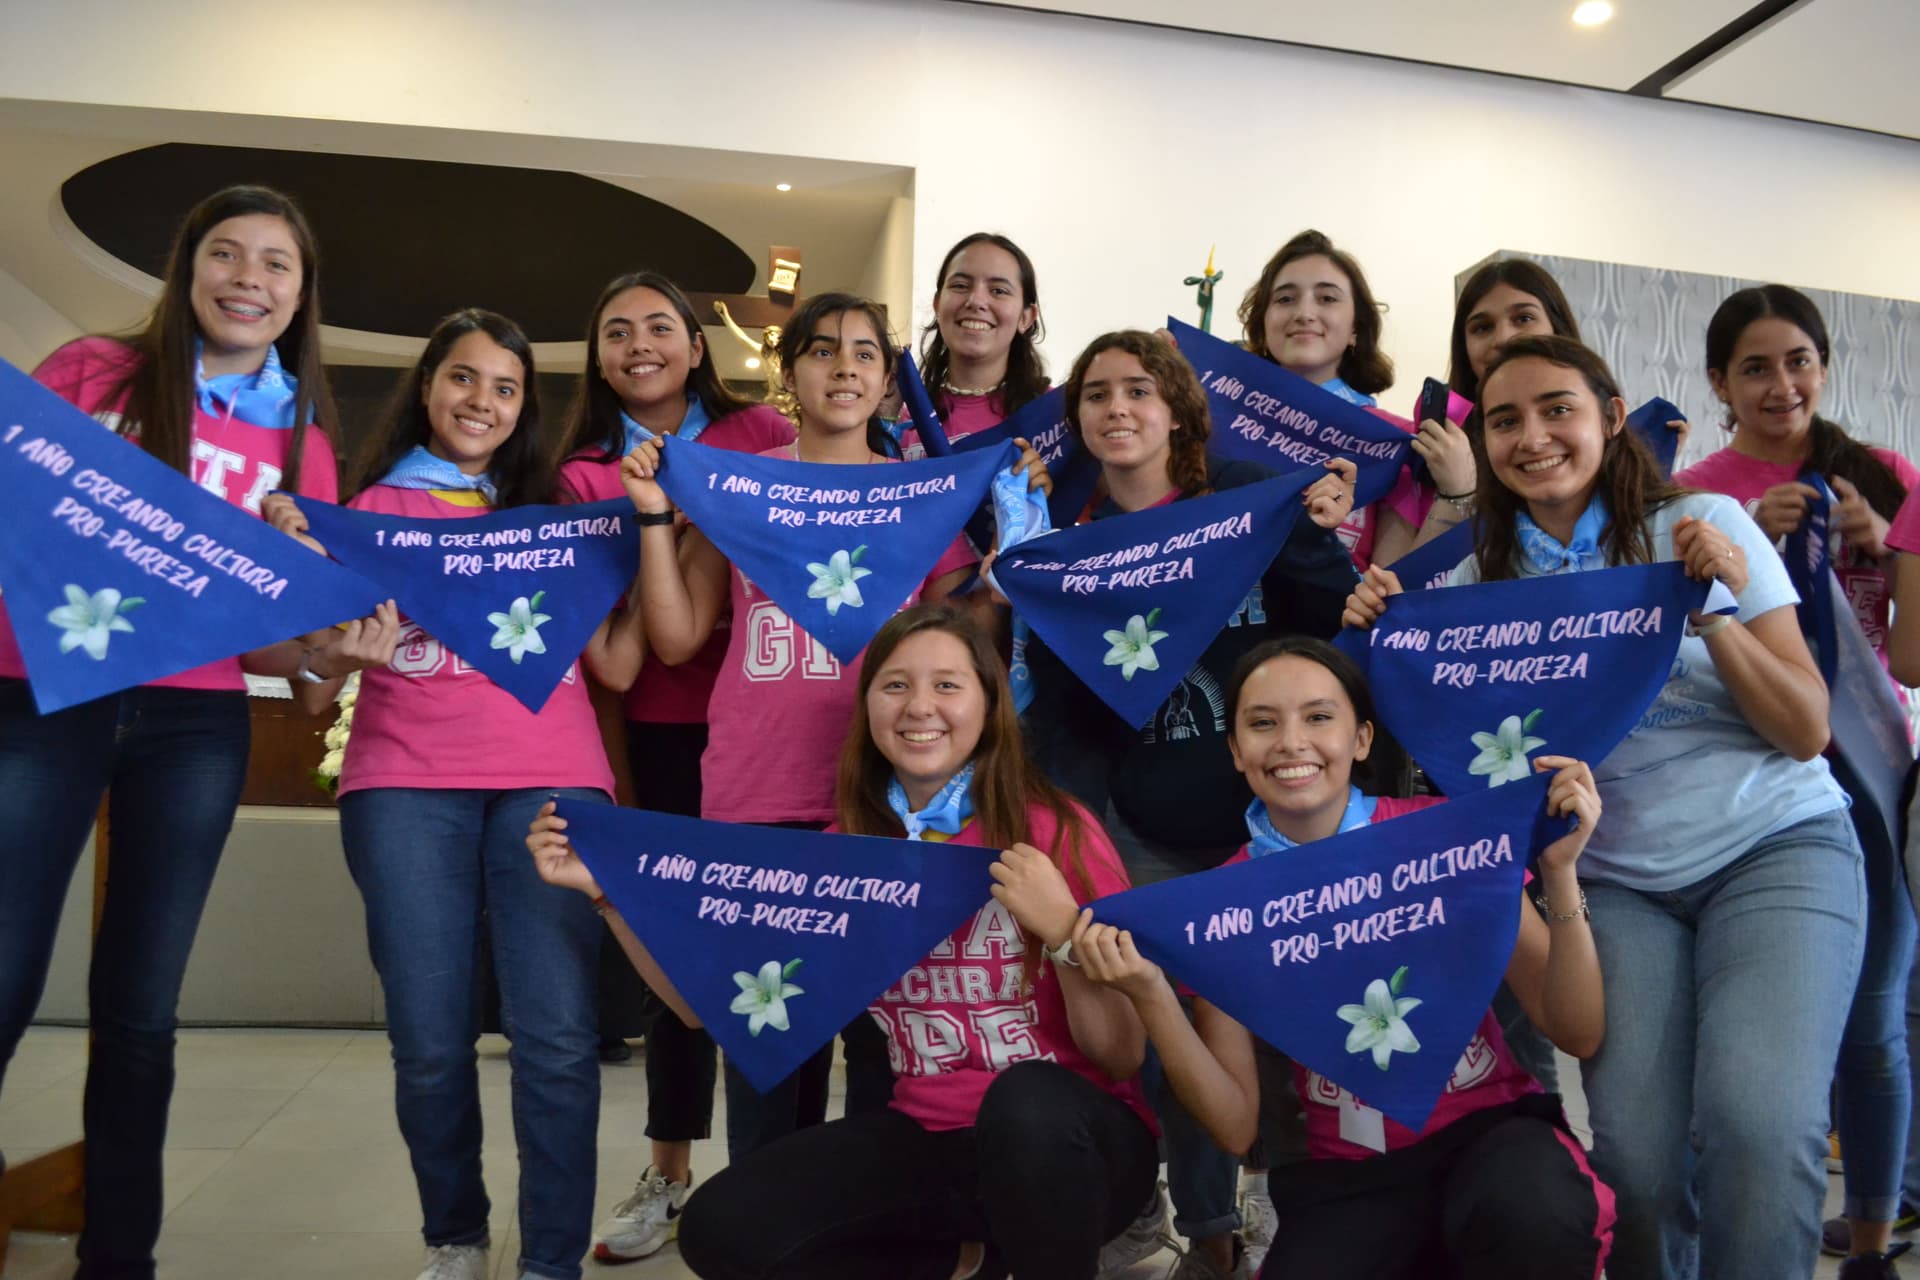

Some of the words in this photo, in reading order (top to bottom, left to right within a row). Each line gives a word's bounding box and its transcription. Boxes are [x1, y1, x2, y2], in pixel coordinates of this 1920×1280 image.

[1200, 370, 1213, 384] 1
[1210, 375, 1245, 400] AÑO
[1243, 390, 1318, 436] CREANDO
[1319, 426, 1401, 460] CULTURA
[1230, 413, 1333, 467] PRO-PUREZ
[2, 425, 24, 444] 1
[19, 437, 75, 477] AÑO
[72, 468, 186, 542] CREANDO
[181, 533, 289, 601] CULTURA
[708, 472, 716, 489] 1
[721, 474, 761, 496] AÑO
[767, 484, 860, 505] CREANDO
[867, 474, 956, 503] CULTURA
[375, 529, 385, 547] 1
[391, 529, 432, 548] AÑO
[439, 528, 532, 548] CREANDO
[538, 515, 622, 541] CULTURA
[768, 506, 902, 528] PRO-PUREZA
[1067, 542, 1159, 572] CREANDO
[1162, 511, 1252, 553] CULTURA
[52, 496, 210, 598] PRO-PUREZA
[443, 547, 575, 576] PRO-PUREZA
[1061, 556, 1194, 595] PRO-PUREZA
[1382, 627, 1430, 652] AÑO
[1436, 620, 1542, 653] CREANDO
[1548, 606, 1662, 643] CULTURA
[1432, 652, 1589, 689] PRO-PUREZA
[637, 853, 649, 874] 1
[651, 853, 696, 882] AÑO
[701, 861, 808, 897] CREANDO
[813, 874, 922, 908] CULTURA
[1184, 921, 1195, 945] 1
[1204, 906, 1252, 942] AÑO
[1262, 872, 1383, 928] CREANDO
[1391, 833, 1513, 892] CULTURA
[697, 896, 850, 938] PRO-PUREZA
[1270, 896, 1446, 967] PRO-PUREZA
